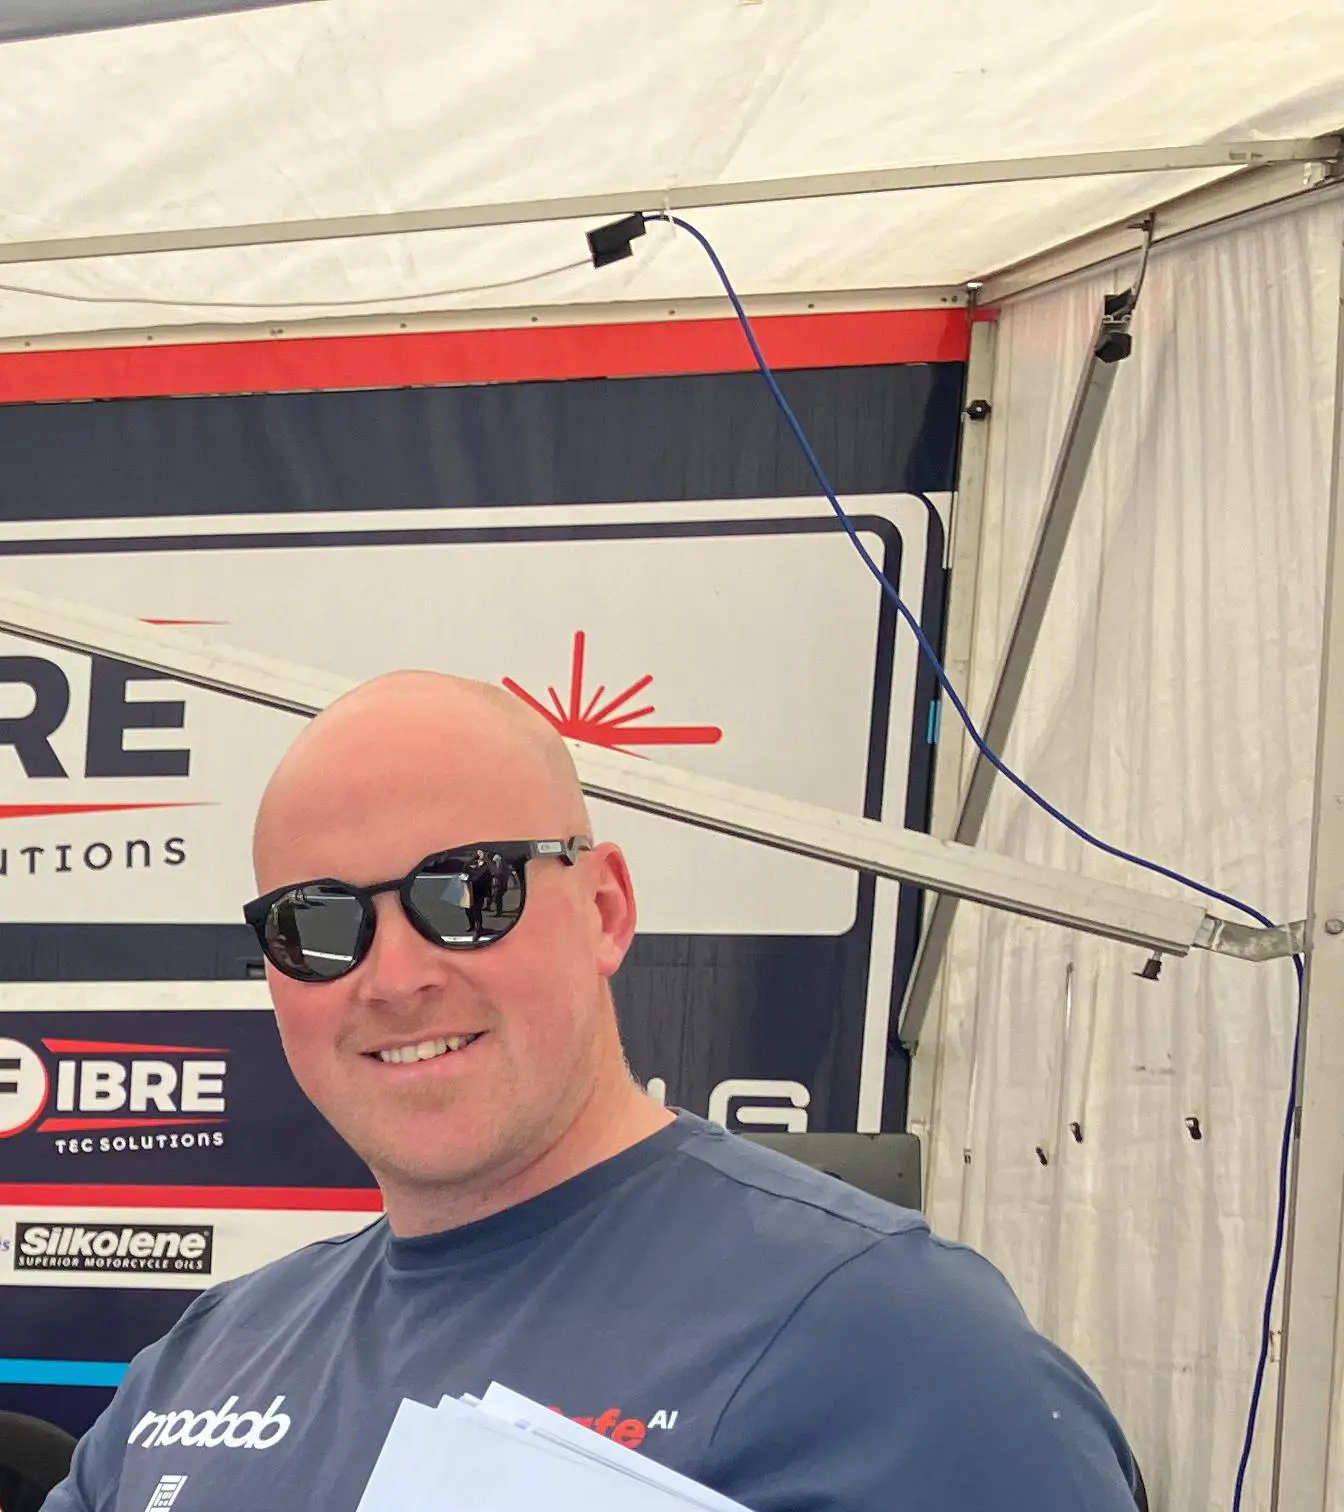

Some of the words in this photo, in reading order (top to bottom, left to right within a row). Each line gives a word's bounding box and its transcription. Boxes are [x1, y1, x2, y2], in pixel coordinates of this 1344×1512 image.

[55, 1138, 94, 1154] TEC
[99, 1131, 225, 1152] SOLUTIONS
[20, 1225, 207, 1260] Silkolene
[18, 1256, 79, 1267] SUPERIOR
[84, 1257, 169, 1269] MOTORCYCLE
[174, 1259, 204, 1271] OILS
[647, 1409, 680, 1429] AI
